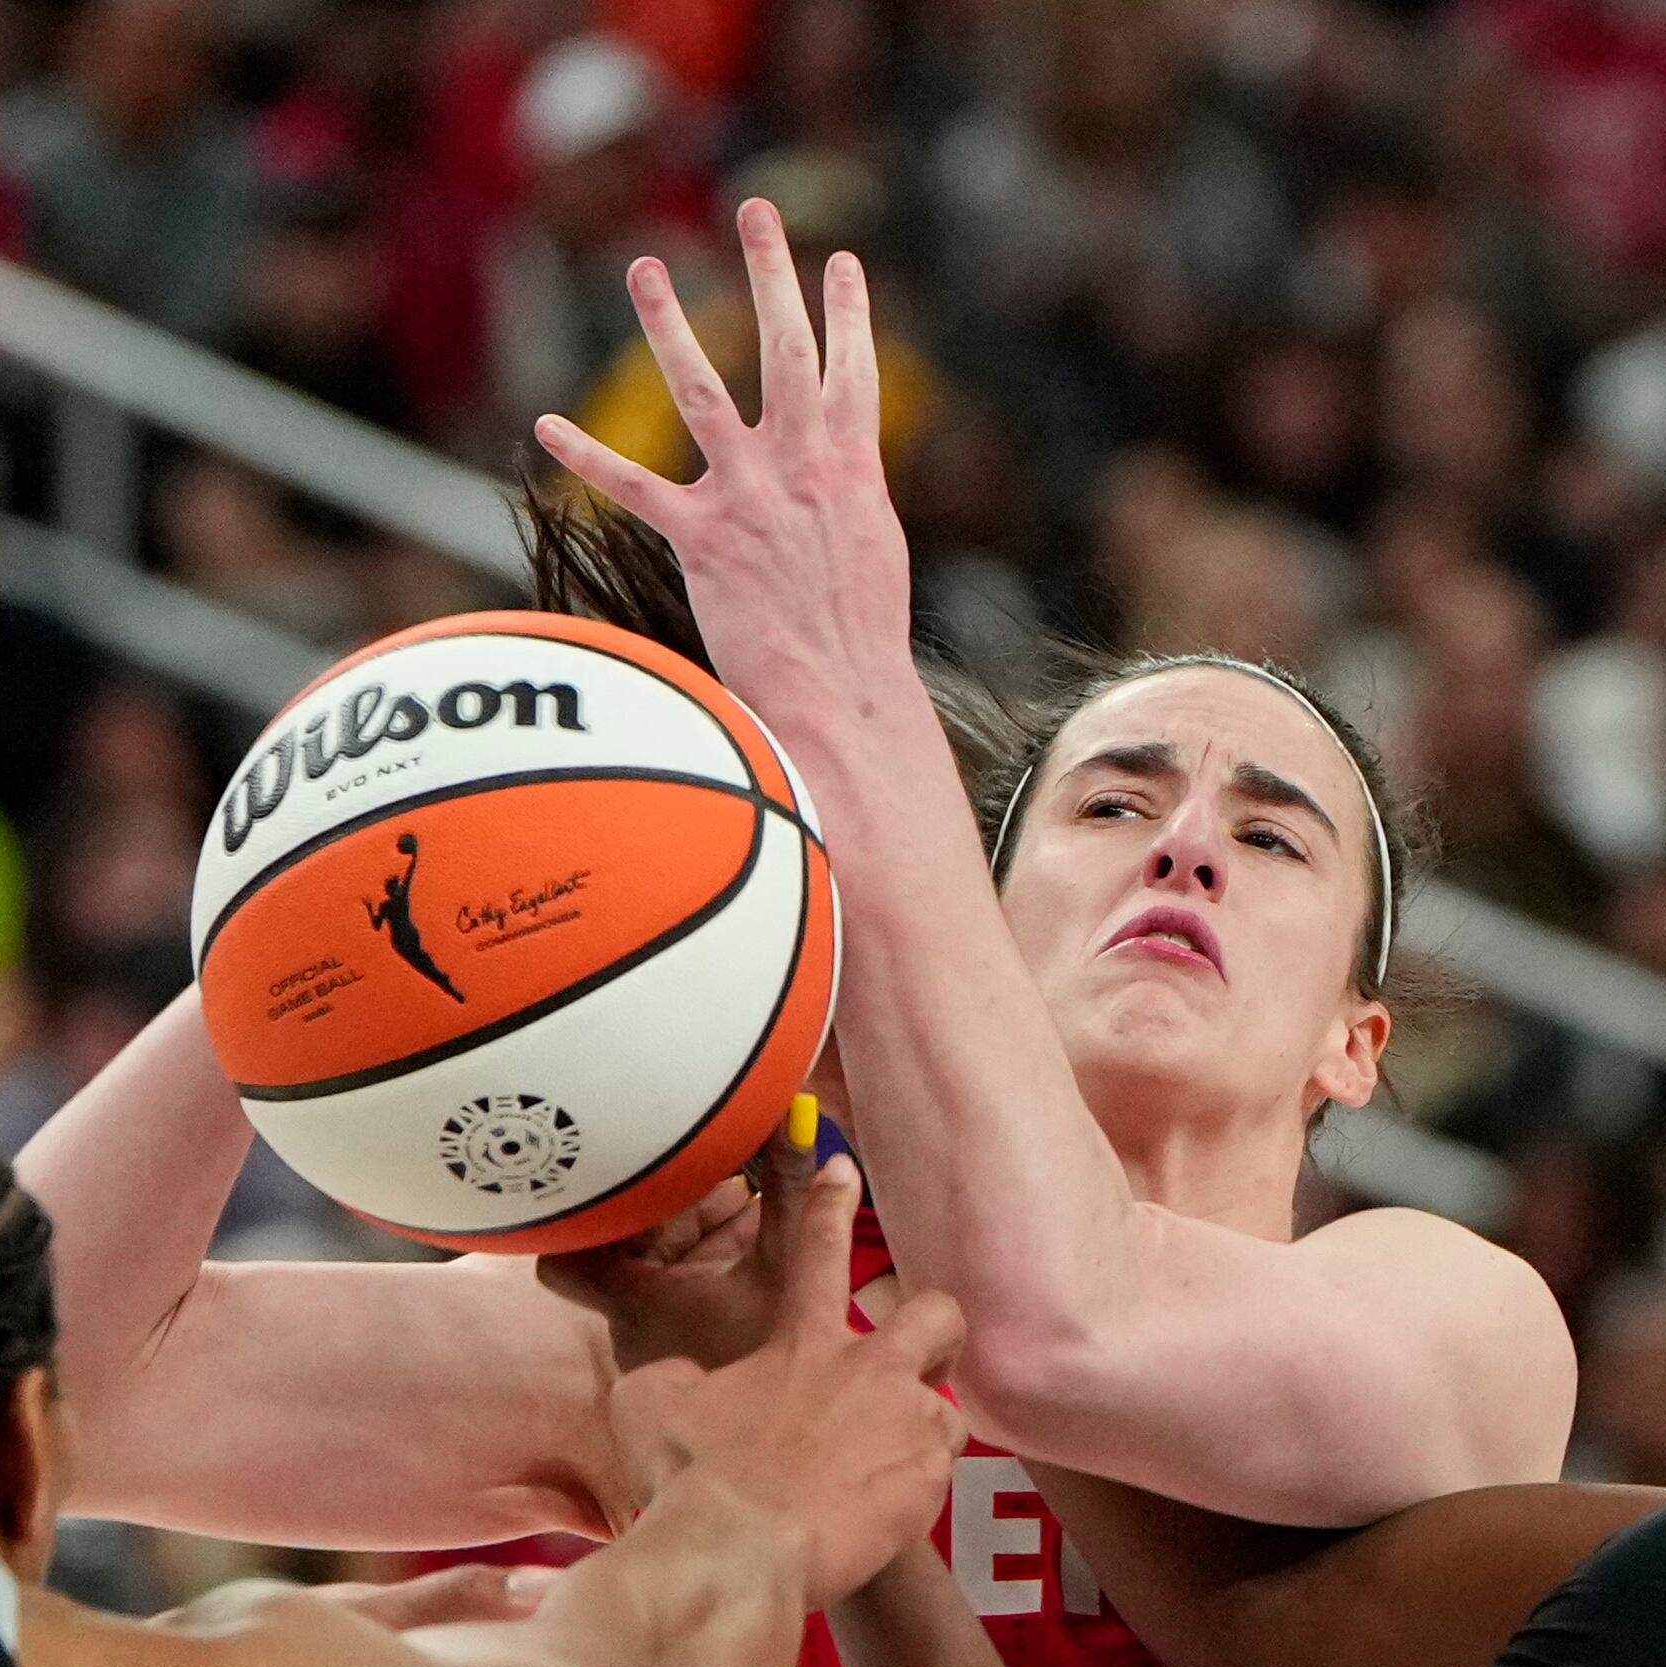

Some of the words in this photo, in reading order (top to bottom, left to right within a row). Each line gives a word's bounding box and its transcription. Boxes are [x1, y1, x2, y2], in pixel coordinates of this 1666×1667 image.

[222, 683, 588, 854] Wilson
[326, 775, 367, 801] EVO
[377, 756, 422, 778] NXT
[268, 990, 314, 1022] GAME
[316, 969, 366, 998] BALL
[269, 955, 345, 998] OFFICIAL
